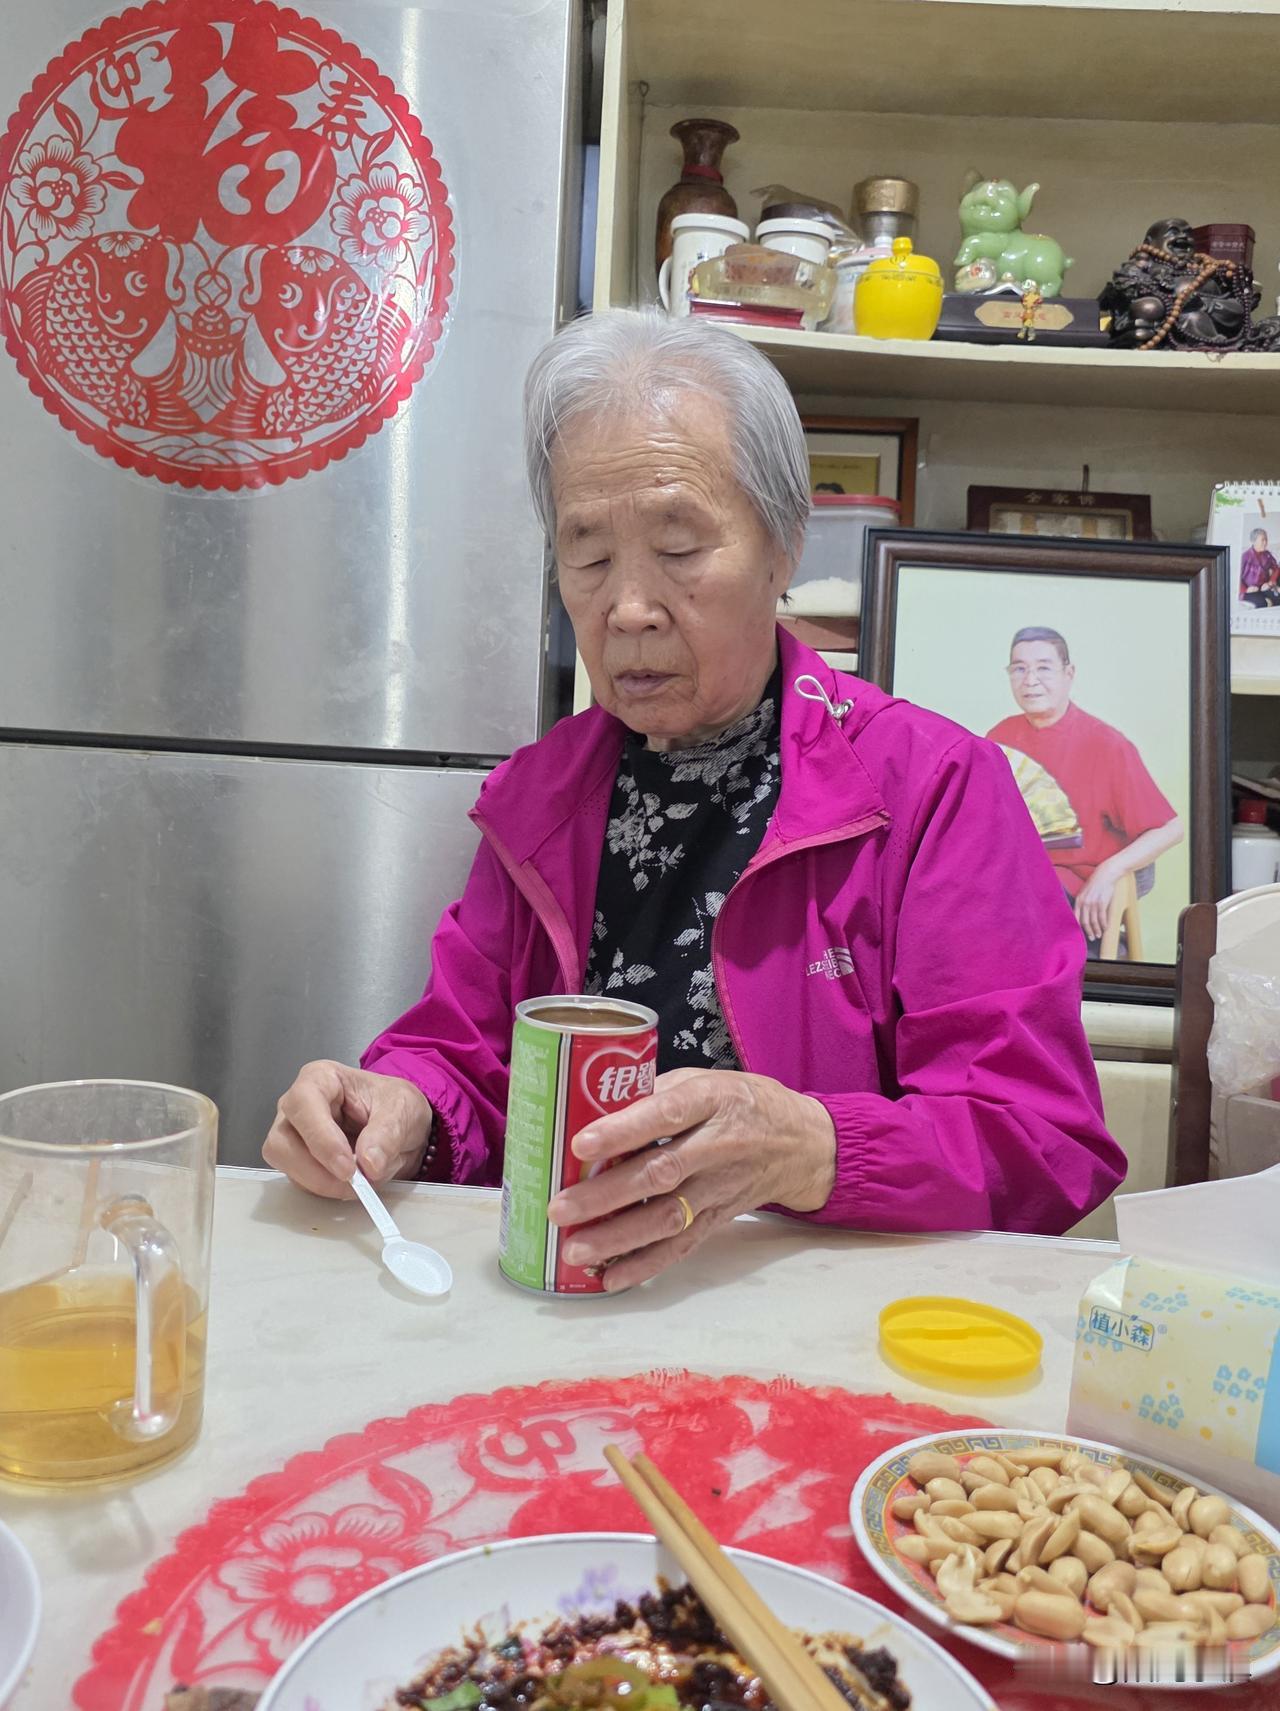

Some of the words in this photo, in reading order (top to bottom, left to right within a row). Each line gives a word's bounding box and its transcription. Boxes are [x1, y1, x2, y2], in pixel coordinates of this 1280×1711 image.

[113, 6, 337, 247] 福
[316, 62, 370, 152] 春
[1091, 1311, 1150, 1347] 植小森
